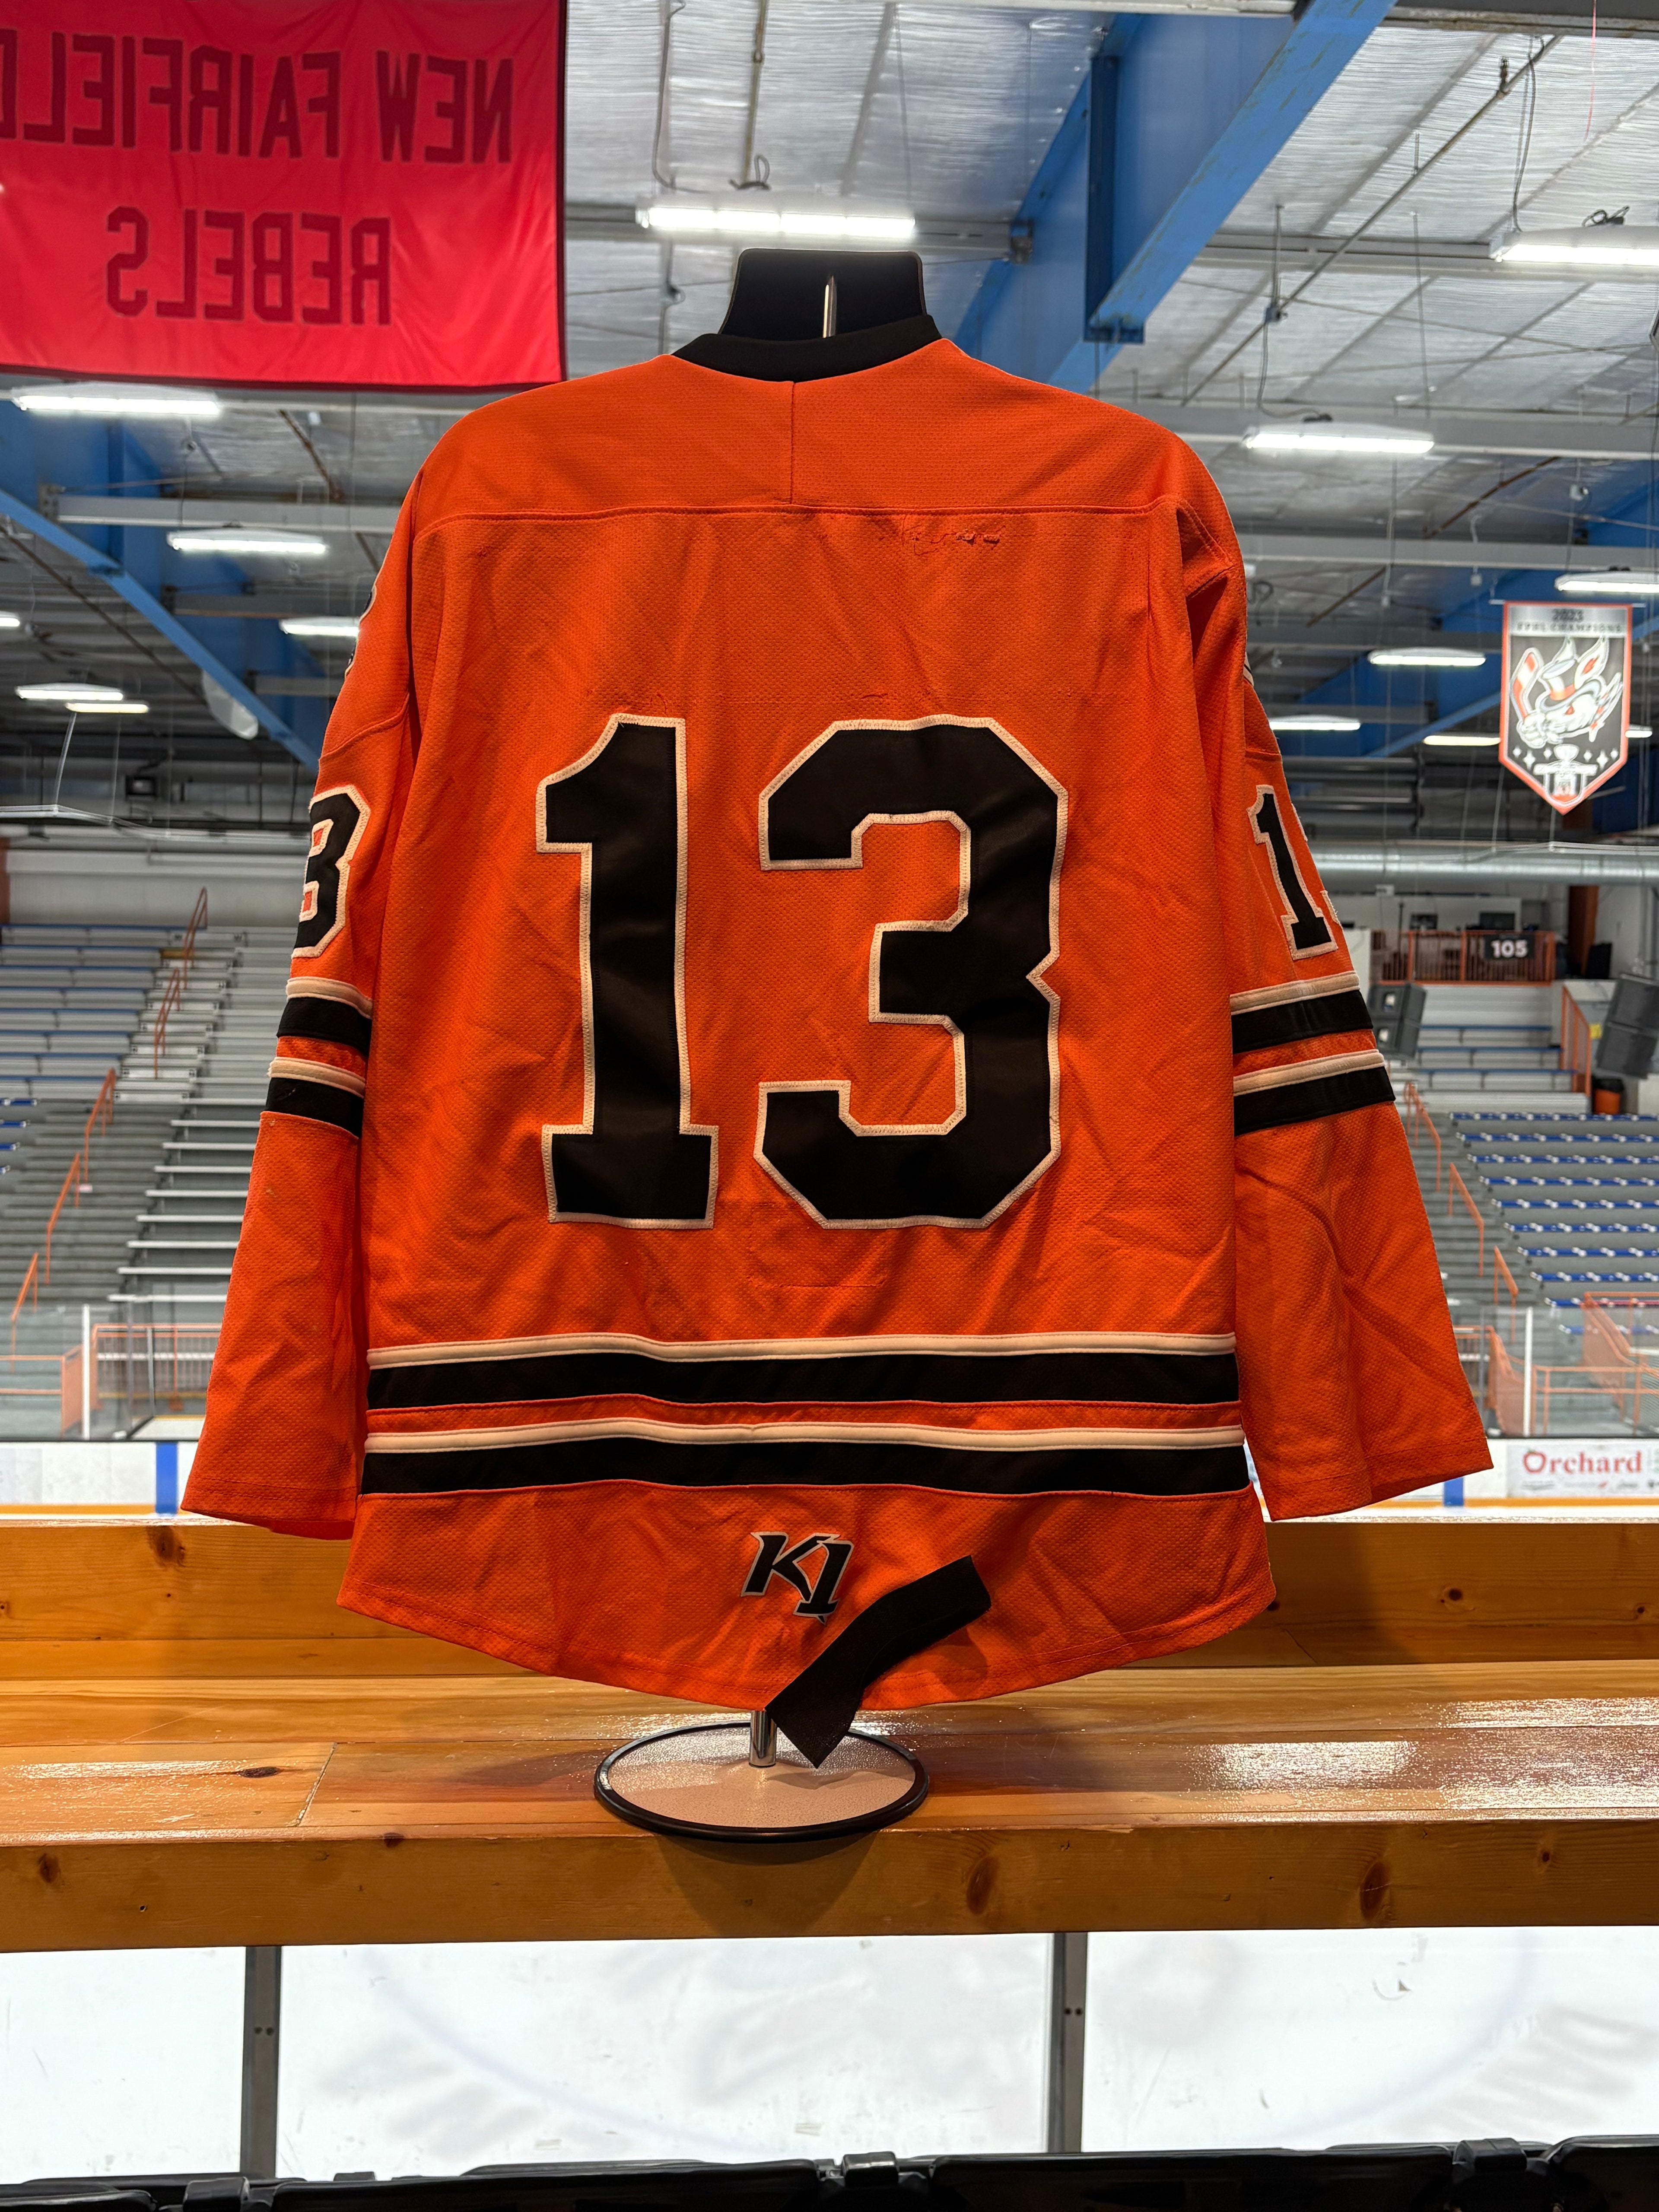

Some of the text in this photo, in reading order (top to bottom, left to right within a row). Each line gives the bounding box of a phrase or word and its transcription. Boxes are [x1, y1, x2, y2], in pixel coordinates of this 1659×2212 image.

[1552, 608, 1584, 622] 2023
[1246, 784, 1339, 960] 1
[536, 713, 1069, 1229] 13
[1491, 939, 1528, 958] 105
[1523, 1450, 1642, 1474] Orchard
[741, 1531, 854, 1625] K1
